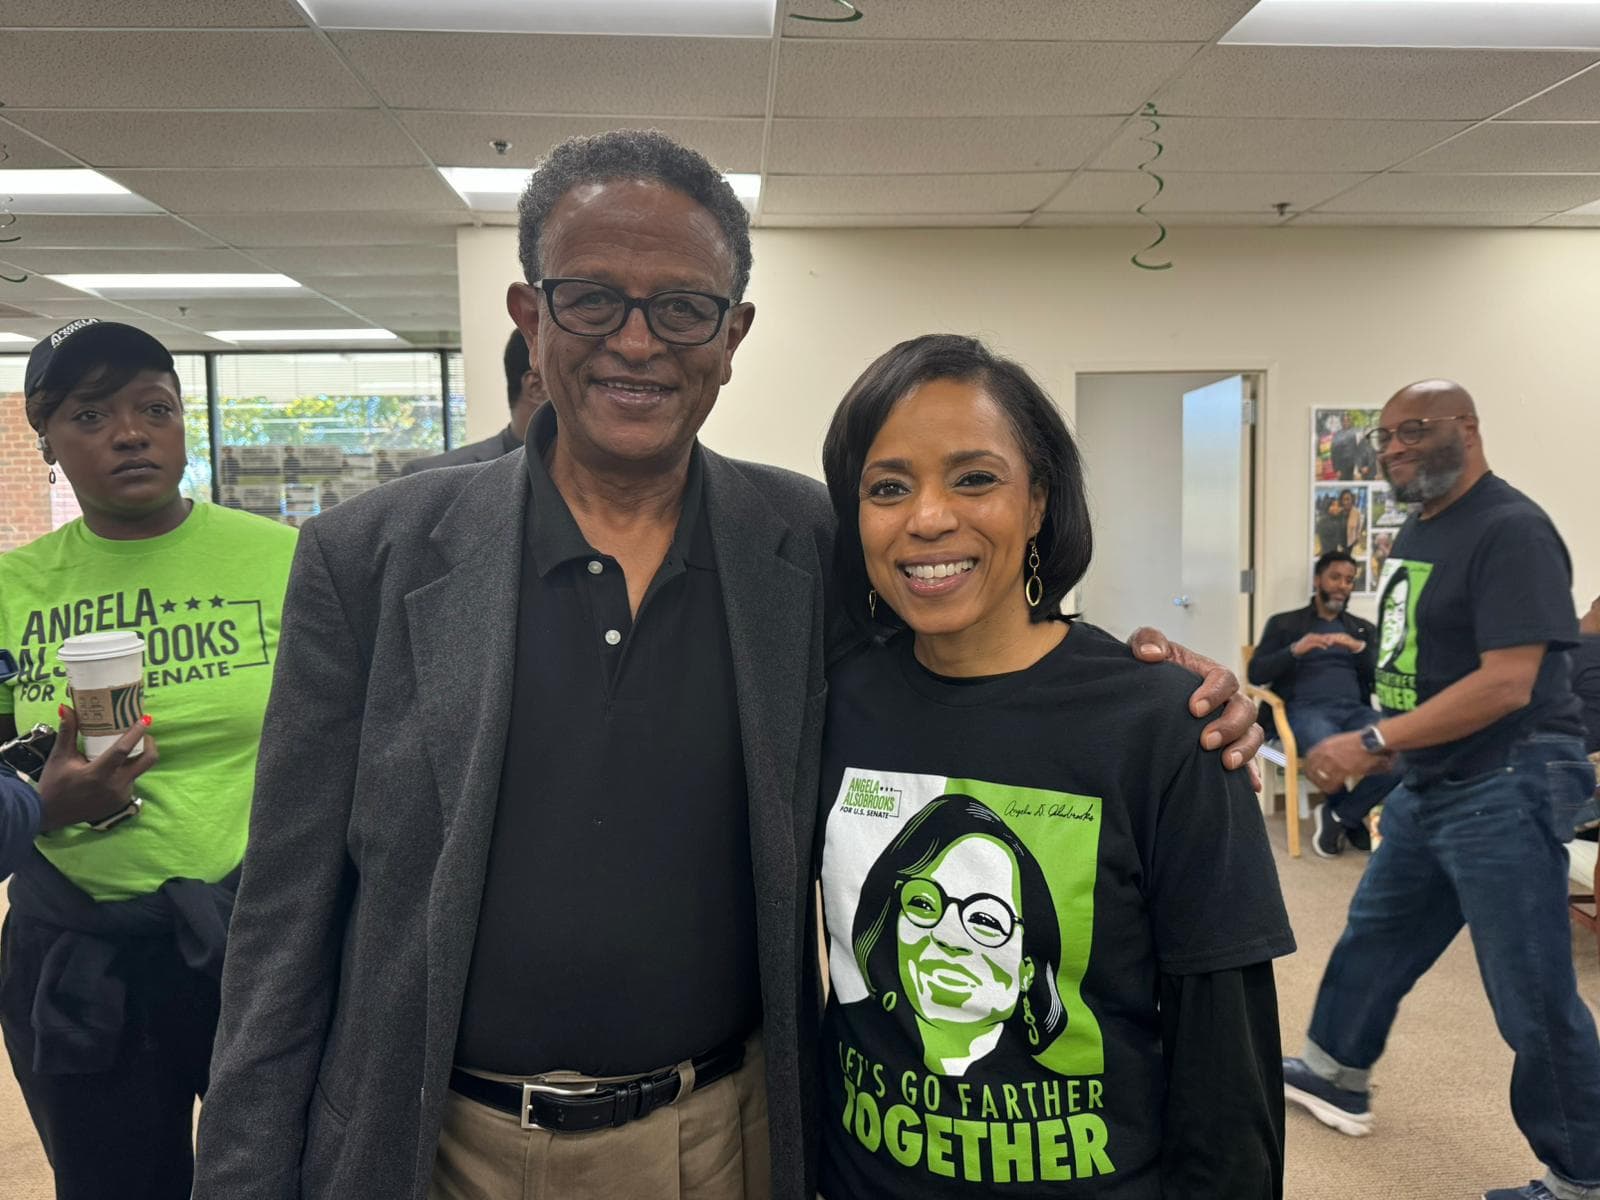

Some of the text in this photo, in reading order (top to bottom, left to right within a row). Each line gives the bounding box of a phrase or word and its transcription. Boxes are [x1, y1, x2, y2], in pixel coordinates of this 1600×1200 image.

[22, 588, 158, 646] ANGELA
[20, 682, 55, 702] FOR
[148, 661, 230, 688] ENATE
[843, 791, 895, 812] ALSOBROOKS
[848, 777, 880, 794] ANGELA
[853, 808, 865, 816] U.S.
[867, 810, 889, 819] SENATE
[839, 1041, 1104, 1120] LET'S GO FARTHER
[842, 1076, 1116, 1183] TOGETHER
